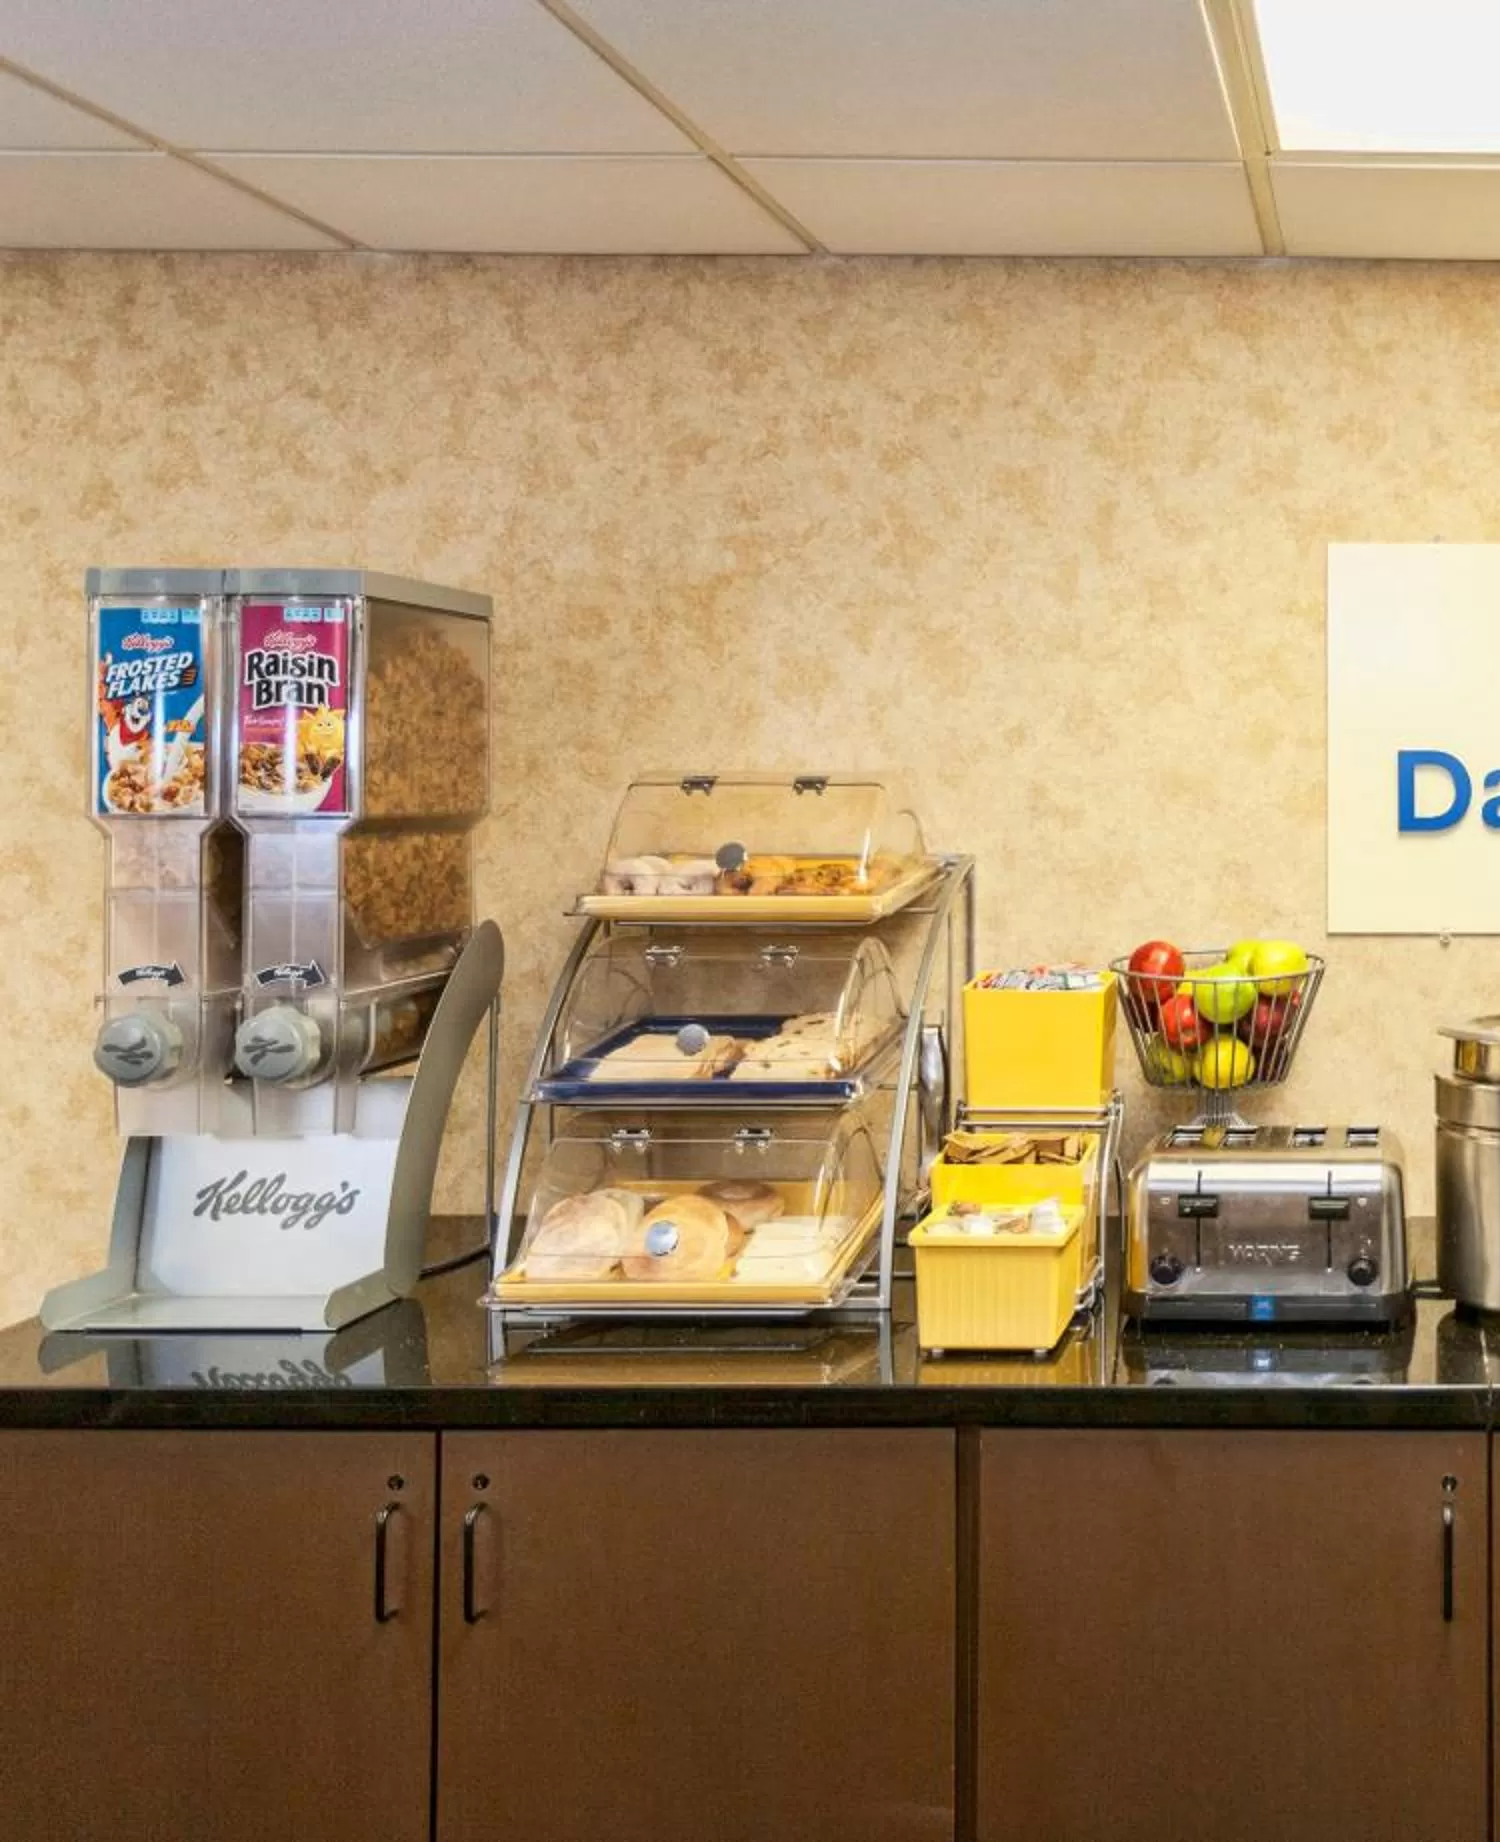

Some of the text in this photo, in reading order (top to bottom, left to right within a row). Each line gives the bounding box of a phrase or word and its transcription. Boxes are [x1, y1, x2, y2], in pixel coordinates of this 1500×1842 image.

[106, 652, 193, 683] FROSTED
[246, 650, 338, 684] Raisin
[107, 670, 182, 699] FLAKES
[254, 679, 327, 708] Bran
[193, 1169, 361, 1230] Kellogg's
